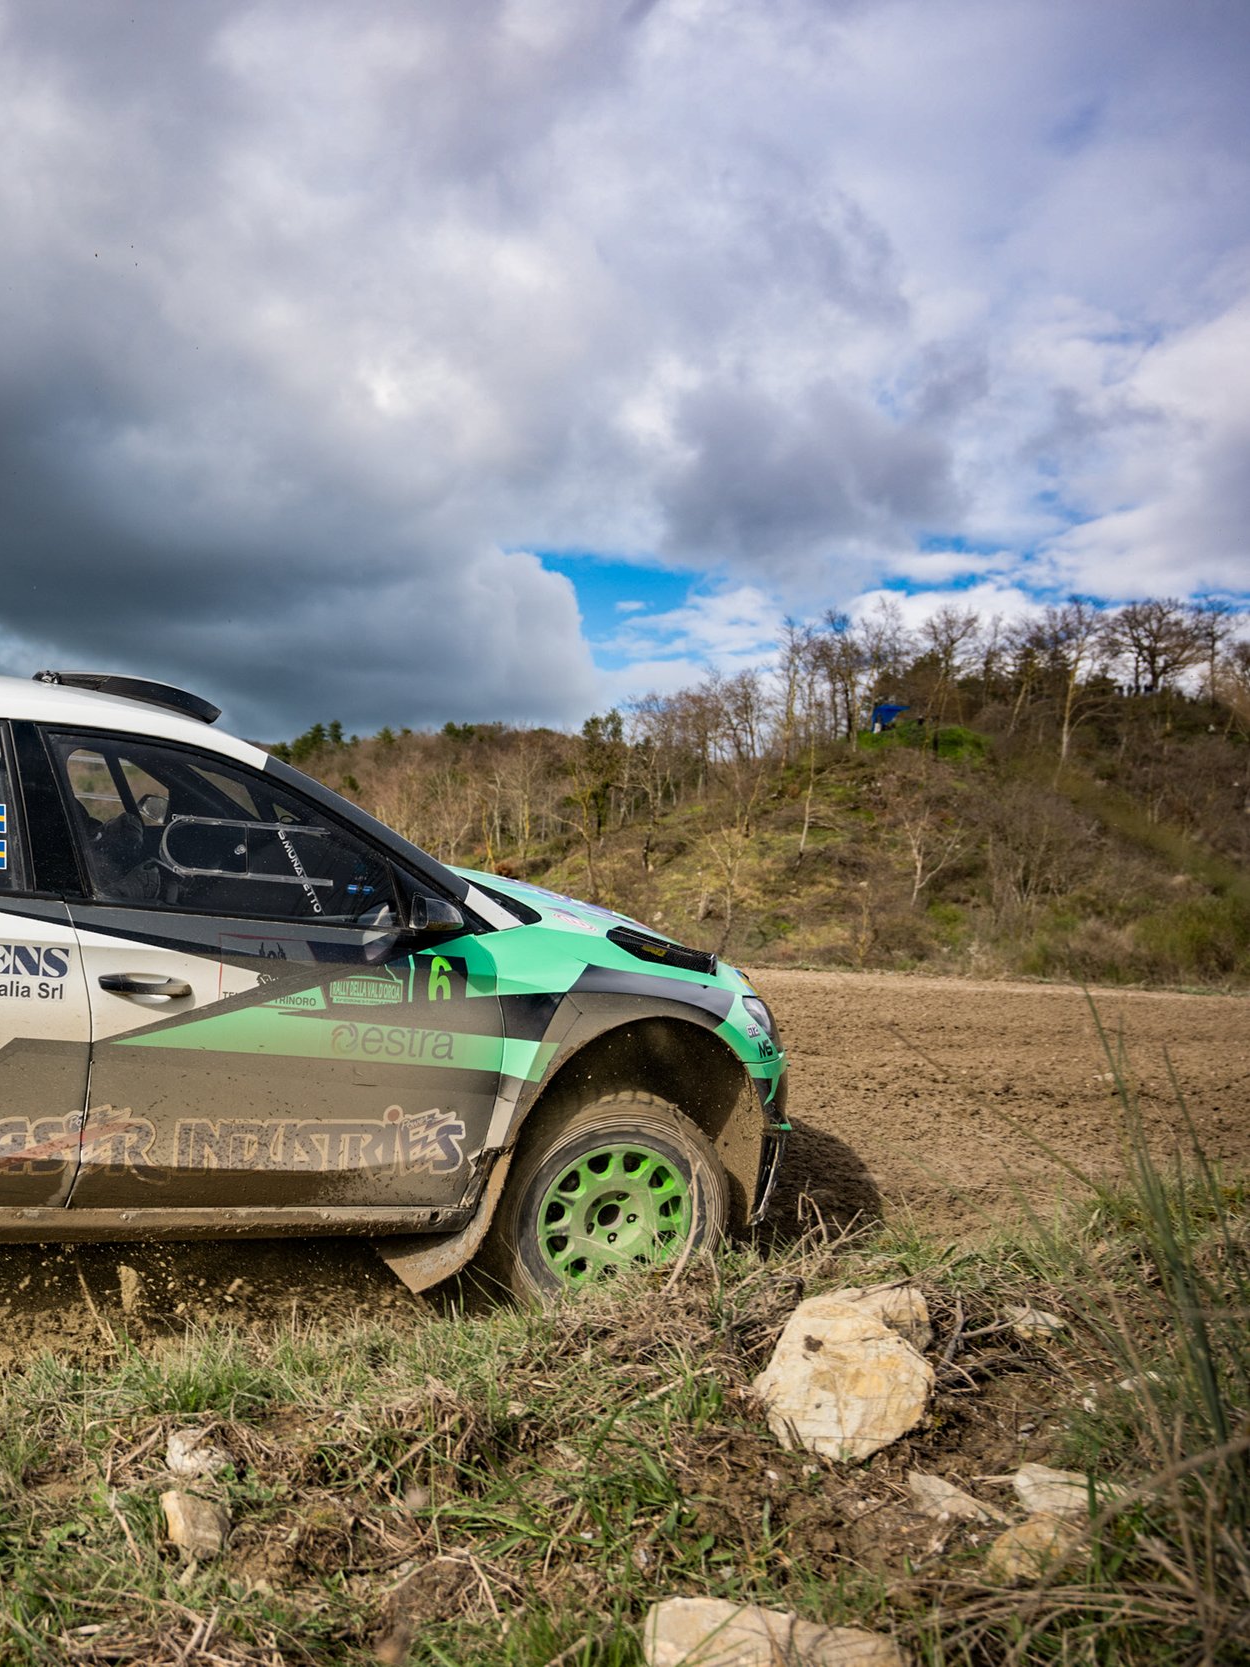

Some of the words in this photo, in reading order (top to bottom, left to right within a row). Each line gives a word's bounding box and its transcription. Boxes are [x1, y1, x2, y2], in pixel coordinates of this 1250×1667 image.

[282, 840, 322, 913] MUNAETTO
[37, 982, 64, 999] Srl
[332, 981, 350, 996] RALLY
[428, 956, 452, 1001] 6
[361, 1026, 454, 1060] estra
